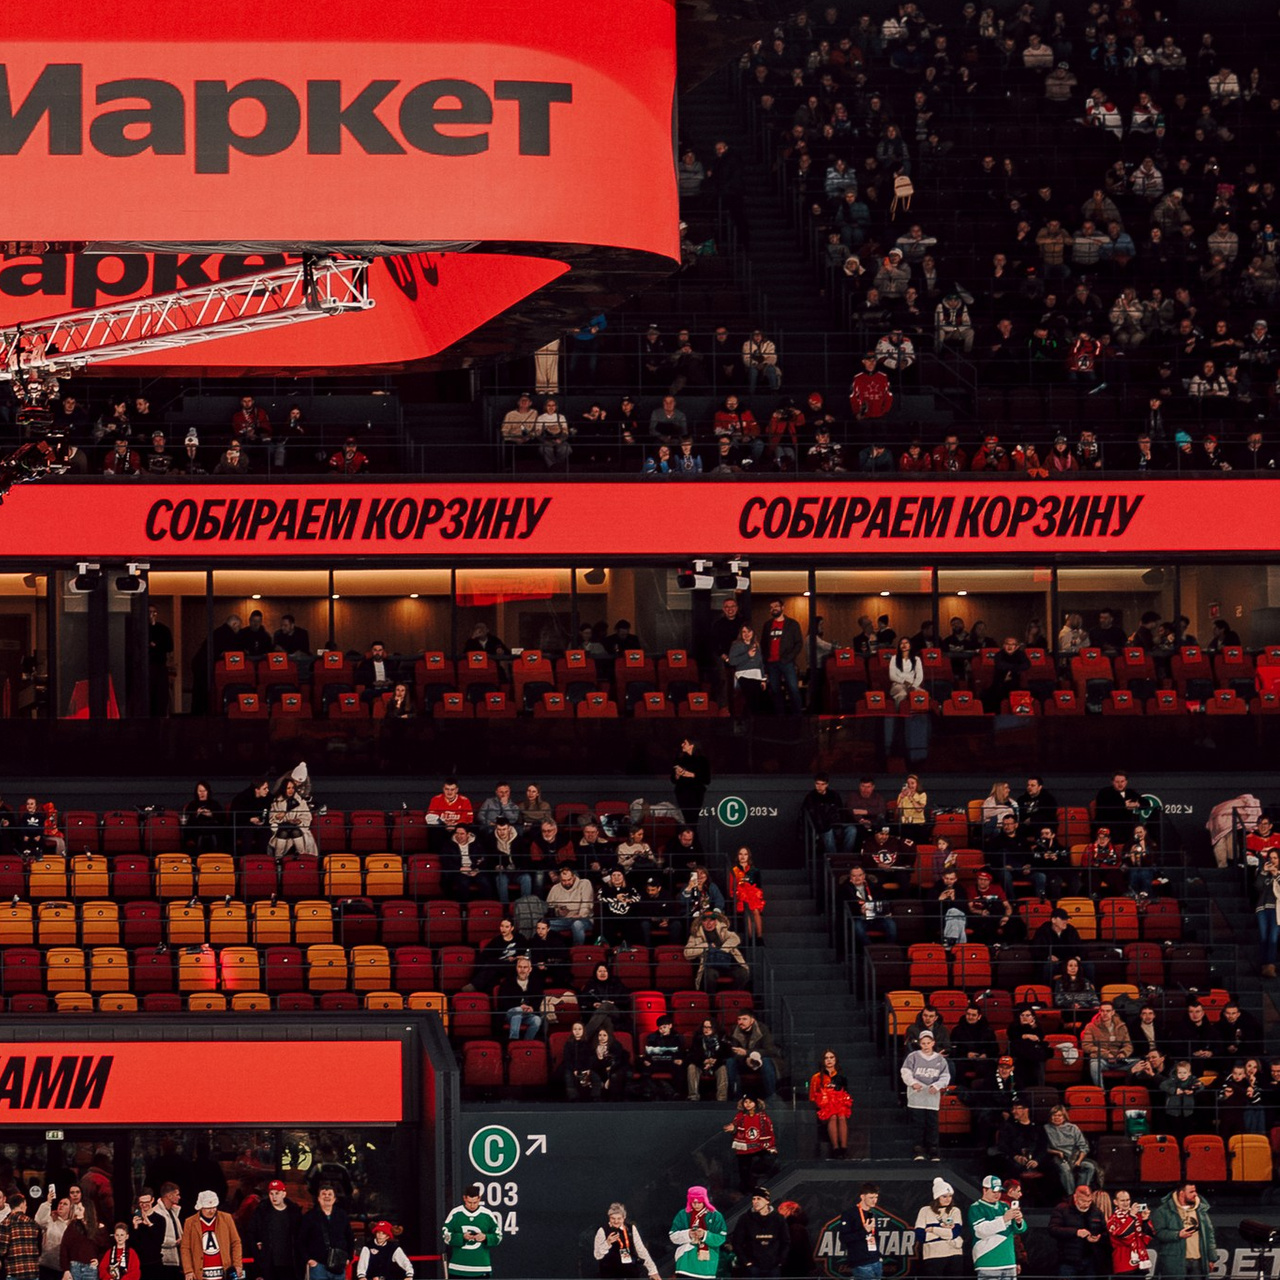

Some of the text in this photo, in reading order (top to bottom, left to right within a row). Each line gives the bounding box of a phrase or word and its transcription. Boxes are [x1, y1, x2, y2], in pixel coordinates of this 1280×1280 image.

[146, 498, 551, 541] СОБИРАЕМ КОРЗИНУ
[739, 496, 1145, 539] СОБИРАЕМ КОРЗИНУ
[750, 807, 767, 816] 203
[1165, 805, 1181, 814] 202
[878, 1231, 916, 1256] TAR
